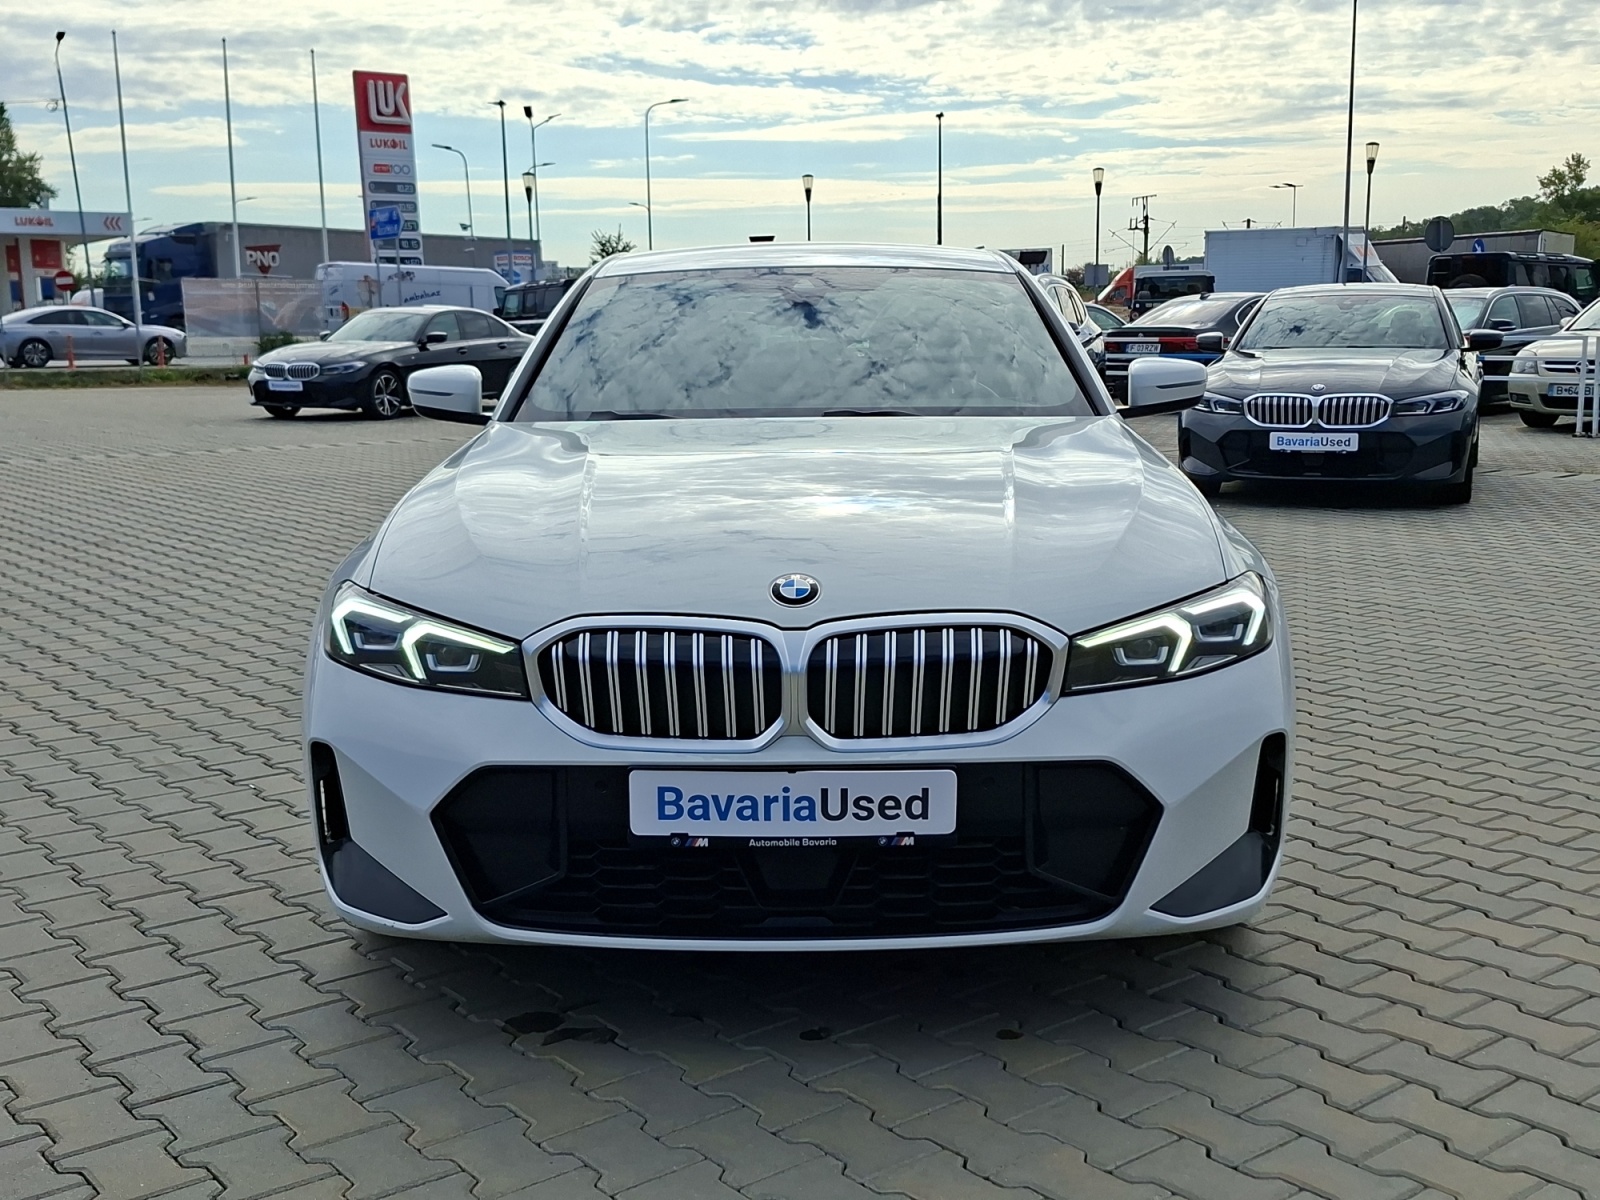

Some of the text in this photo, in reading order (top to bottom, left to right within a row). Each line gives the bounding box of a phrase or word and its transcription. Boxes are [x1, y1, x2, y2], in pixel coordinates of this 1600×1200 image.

[370, 138, 407, 149] LUKOIL
[14, 216, 54, 227] LUKOIL
[246, 250, 280, 267] PNO
[1145, 344, 1159, 352] RZW
[1276, 436, 1351, 447] BavariaUsed
[656, 785, 930, 822] BavariaUsed
[748, 838, 837, 847] Automobile Bavaria
